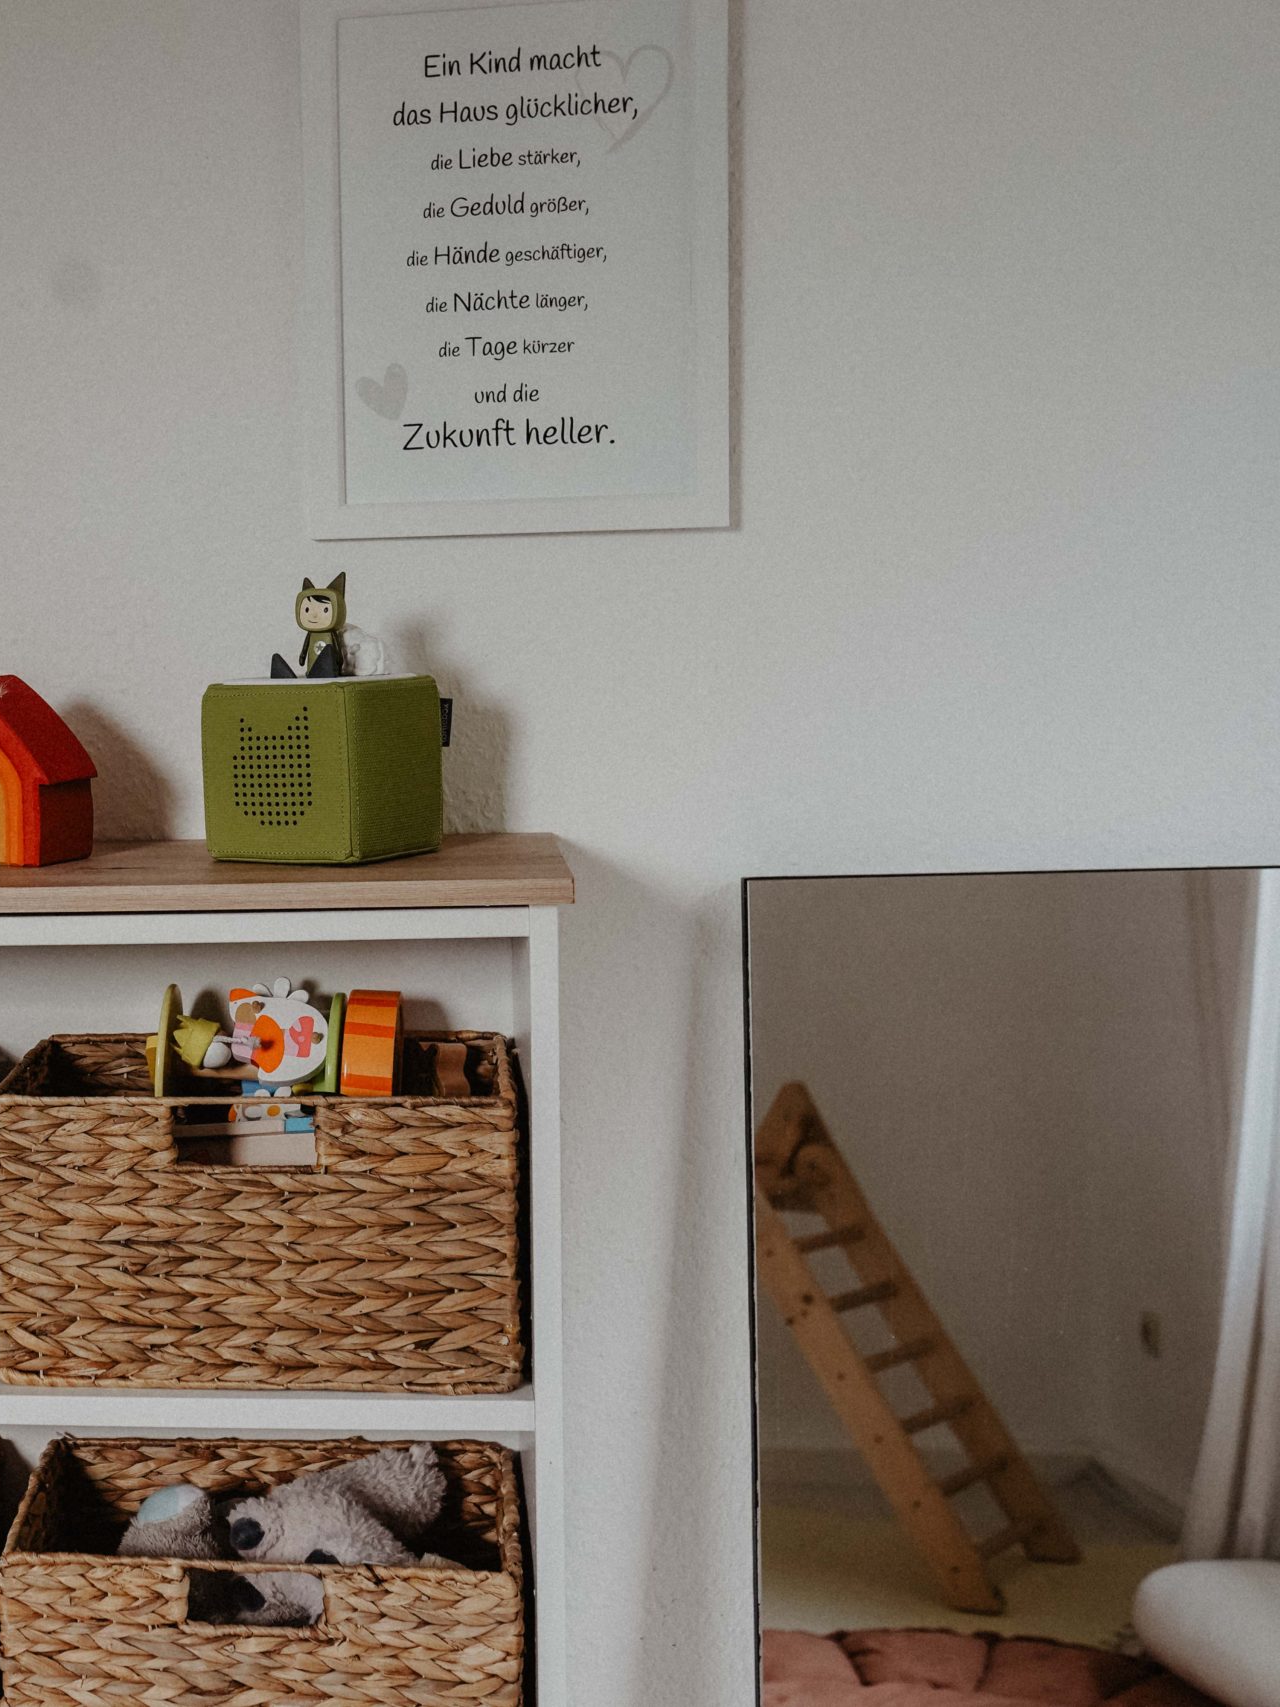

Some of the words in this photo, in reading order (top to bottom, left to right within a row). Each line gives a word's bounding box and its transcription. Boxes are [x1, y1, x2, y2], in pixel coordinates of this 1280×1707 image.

[424, 52, 462, 79] Ein
[469, 46, 522, 76] Kind
[529, 44, 602, 72] macht
[392, 101, 432, 127] das
[439, 100, 499, 124] Haus
[505, 91, 638, 127] glücklicher,
[430, 153, 453, 171] die
[458, 146, 514, 170] Liebe
[518, 147, 581, 168] stärker,
[423, 201, 446, 219] die
[450, 191, 525, 218] Geduld
[529, 196, 589, 218] größer,
[406, 250, 429, 267] die
[434, 240, 501, 265] Hände
[505, 243, 607, 267] geschäftiger,
[425, 296, 448, 313] die
[453, 289, 531, 313] Nächte
[535, 292, 588, 312] länger,
[438, 341, 461, 358] die
[464, 336, 518, 361] Tage
[523, 338, 575, 355] kürzer
[474, 383, 507, 404] und
[512, 382, 540, 403] die
[402, 417, 517, 451] Zukunft
[525, 416, 615, 446] heller.
